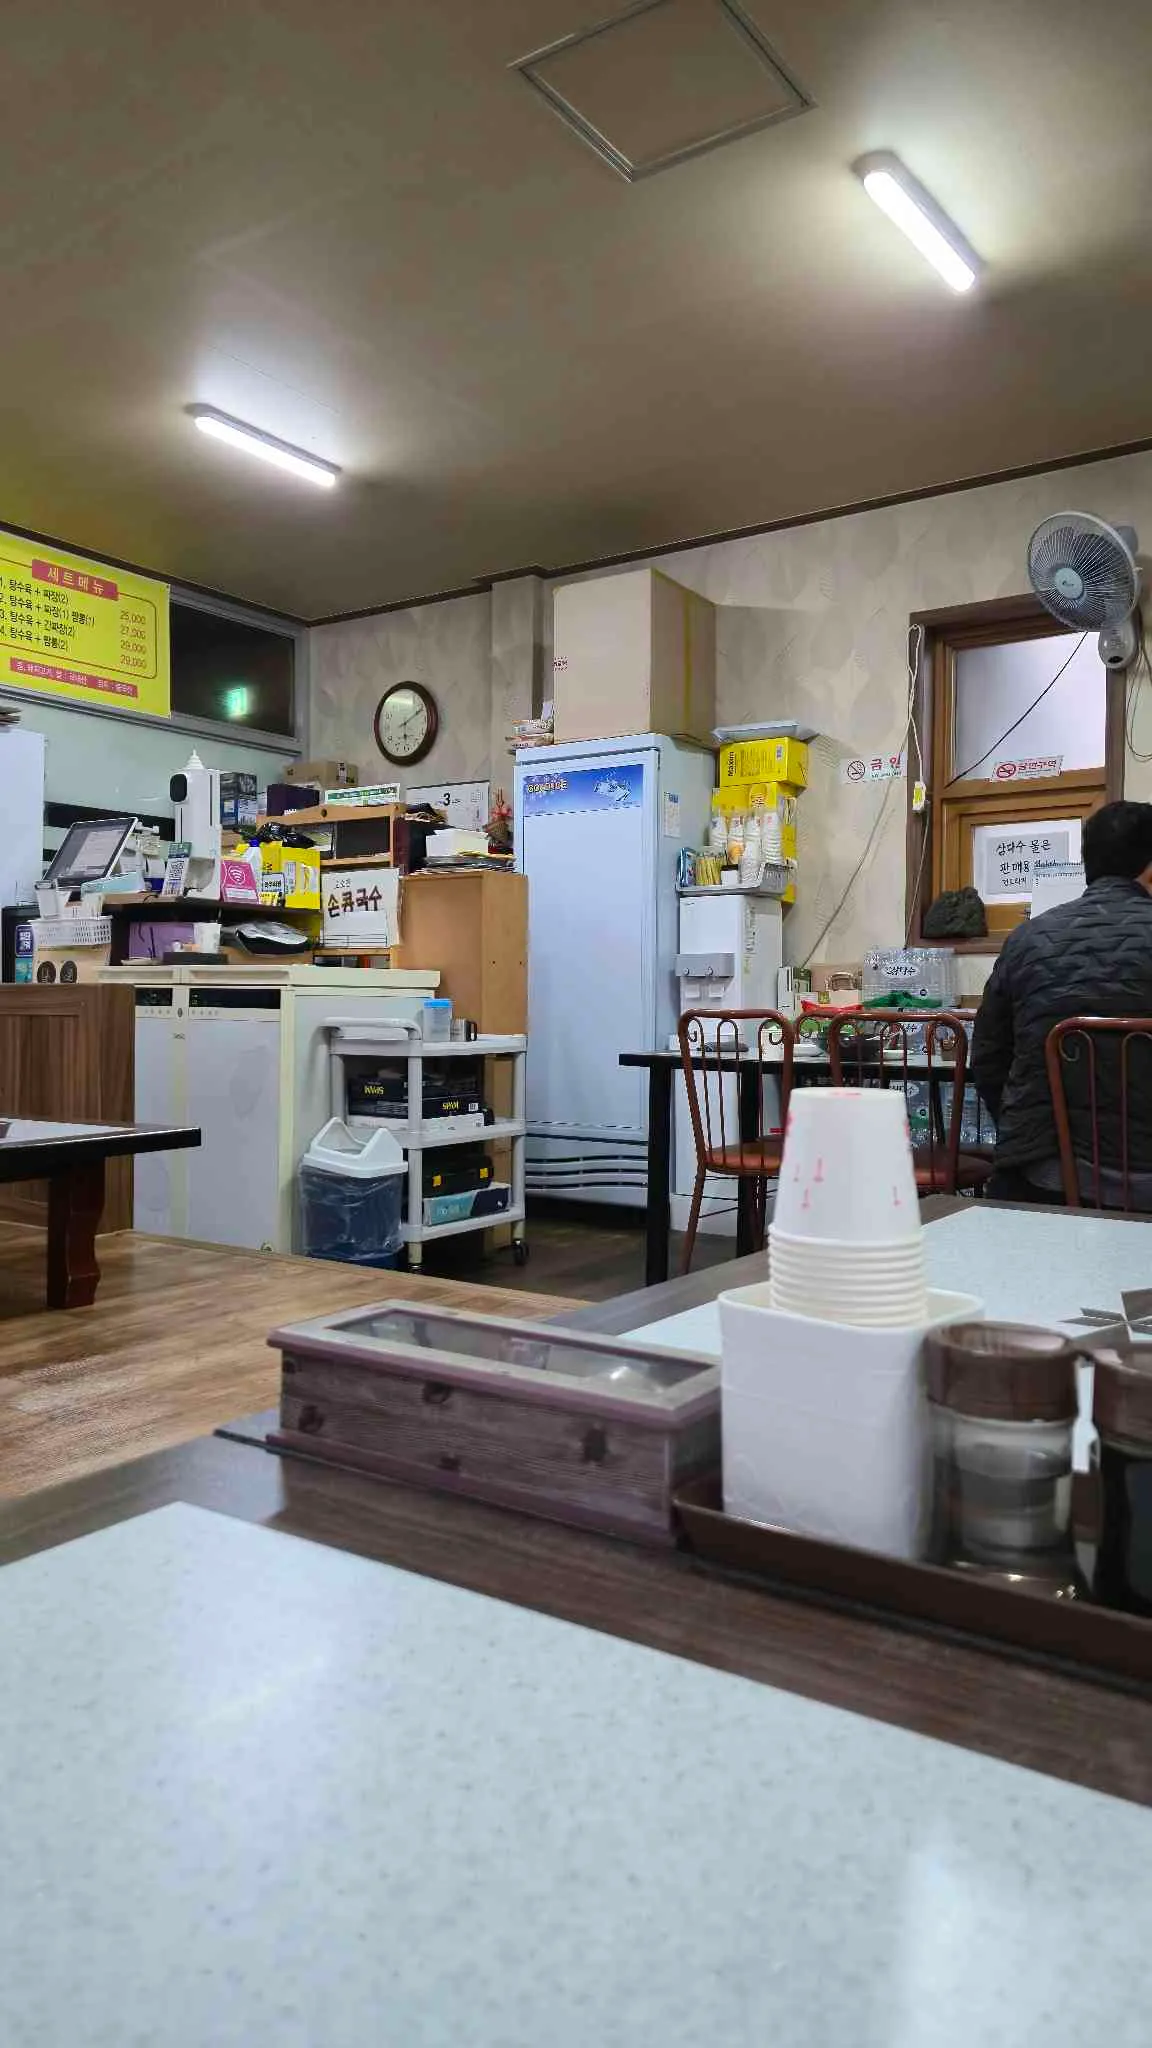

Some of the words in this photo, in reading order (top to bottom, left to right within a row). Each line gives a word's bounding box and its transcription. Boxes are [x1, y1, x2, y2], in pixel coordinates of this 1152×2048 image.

[10, 579, 32, 595] 탕수육
[10, 595, 32, 611] 탕수육
[10, 611, 32, 627] 탕수육
[10, 627, 32, 643] 탕수육
[443, 792, 451, 806] 3
